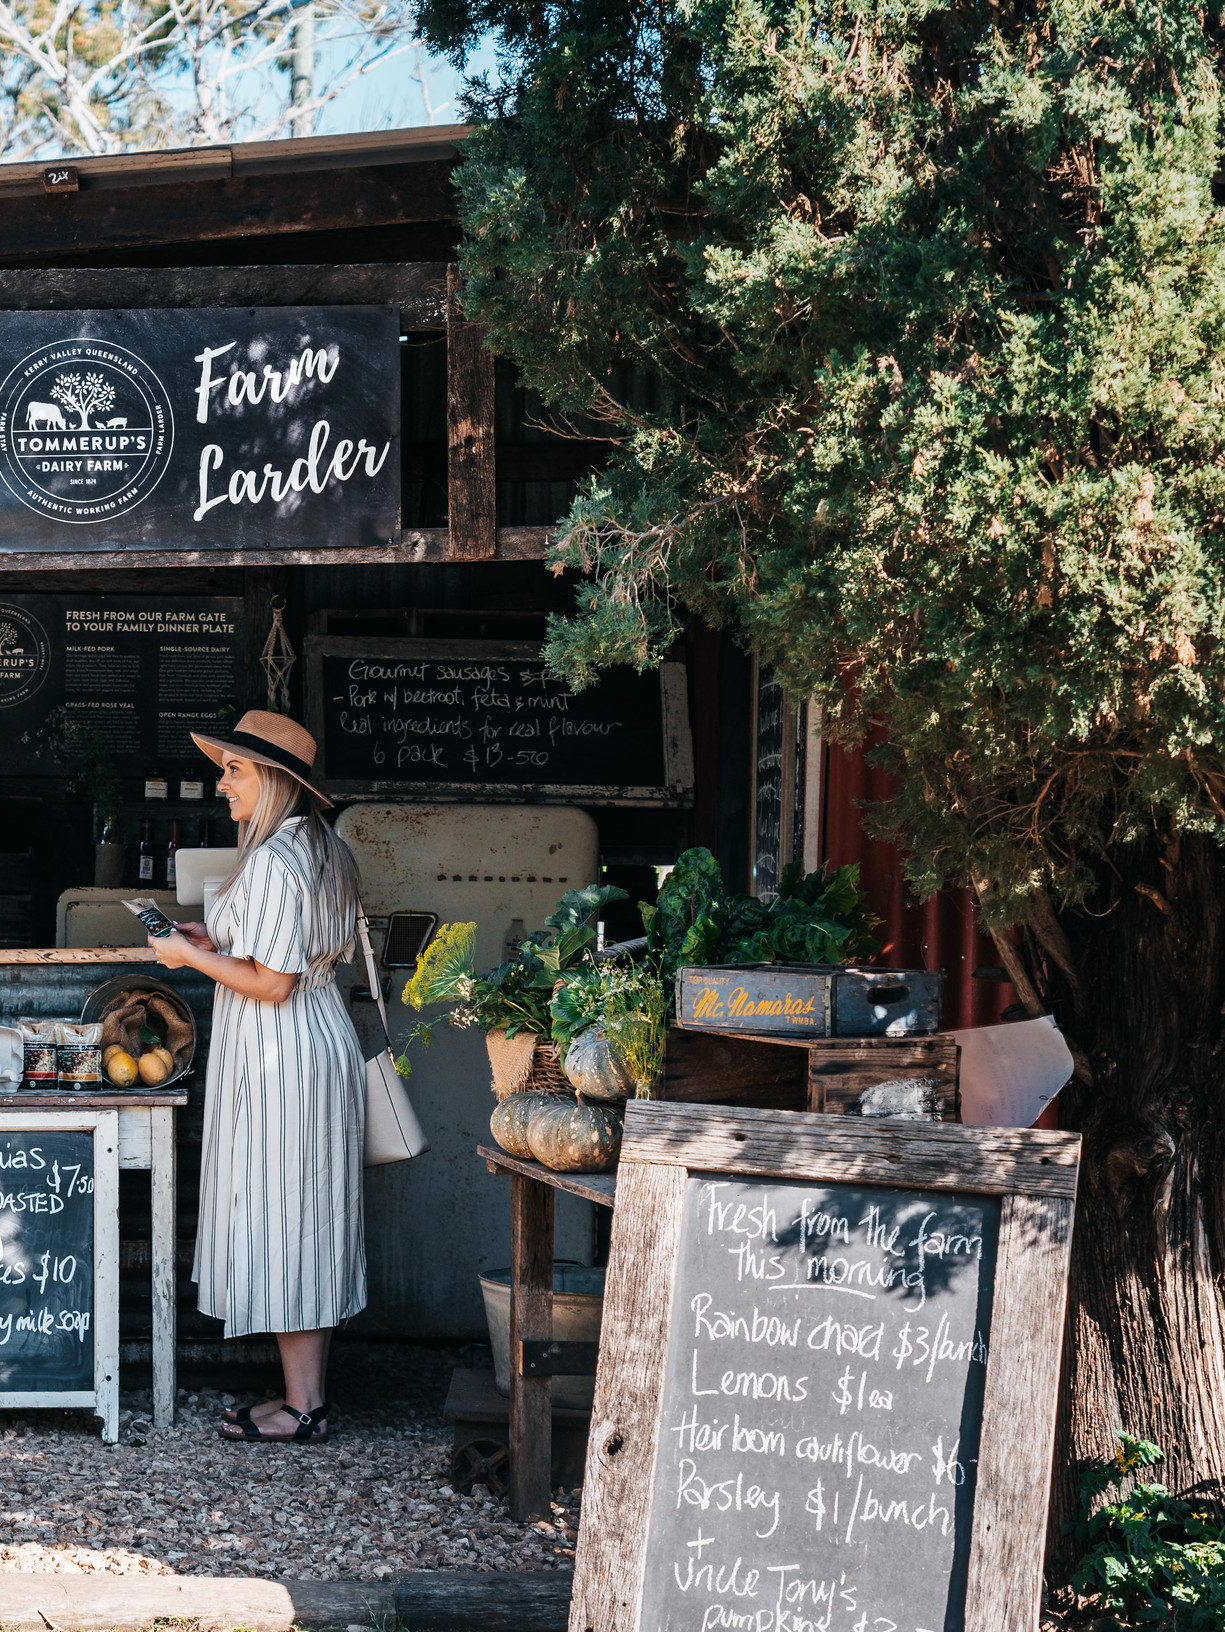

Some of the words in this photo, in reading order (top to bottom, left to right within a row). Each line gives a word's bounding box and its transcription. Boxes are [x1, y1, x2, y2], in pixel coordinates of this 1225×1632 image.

[24, 357, 48, 377] KERRY
[50, 348, 82, 360] VALLEY
[85, 348, 138, 375] QUEENSLAND
[194, 341, 340, 424] Farm
[0, 412, 8, 432] FARM
[155, 404, 165, 433] LARDER
[0, 434, 8, 452] STAY
[17, 435, 146, 452] TOMMERUP'S
[155, 435, 165, 455] FARM
[41, 460, 83, 472] DAIRY
[87, 460, 123, 472] FARM
[193, 420, 390, 522] Larder
[26, 490, 73, 514] AUTHENTIC
[76, 501, 116, 515] WORKING
[117, 487, 139, 505] FARM
[66, 611, 100, 620] FRESH
[103, 611, 135, 621] FROM
[138, 612, 162, 621] OUR
[165, 612, 196, 621] FARM
[199, 613, 226, 622] GATE
[66, 622, 80, 631] TO
[83, 623, 114, 632] YOUR
[117, 623, 154, 632] FAMILY
[157, 624, 199, 633] DINNER
[203, 624, 235, 633] PLATE
[0, 671, 21, 679] FARM
[348, 659, 431, 681] Gourmet
[436, 665, 510, 692] sausages
[348, 684, 377, 708] Pork
[470, 685, 510, 711] feta
[528, 692, 574, 711] mint
[382, 715, 473, 744] ingredients
[479, 714, 503, 744] for
[509, 718, 540, 737] real
[549, 716, 623, 747] flavour
[373, 741, 385, 764] 6
[397, 743, 448, 768] pack
[706, 1182, 779, 1243] Fresh
[792, 1198, 850, 1252] from
[908, 1211, 983, 1268] farm
[32, 1249, 77, 1294] $10
[807, 1257, 926, 1312] morning
[16, 1306, 54, 1335] milk
[55, 1310, 91, 1343] soap
[690, 1293, 802, 1348] Rainbow
[692, 1348, 809, 1402] Lemons
[676, 1458, 780, 1538] Parsley
[674, 1556, 760, 1598] Uncle
[766, 1563, 858, 1624] Tony's
